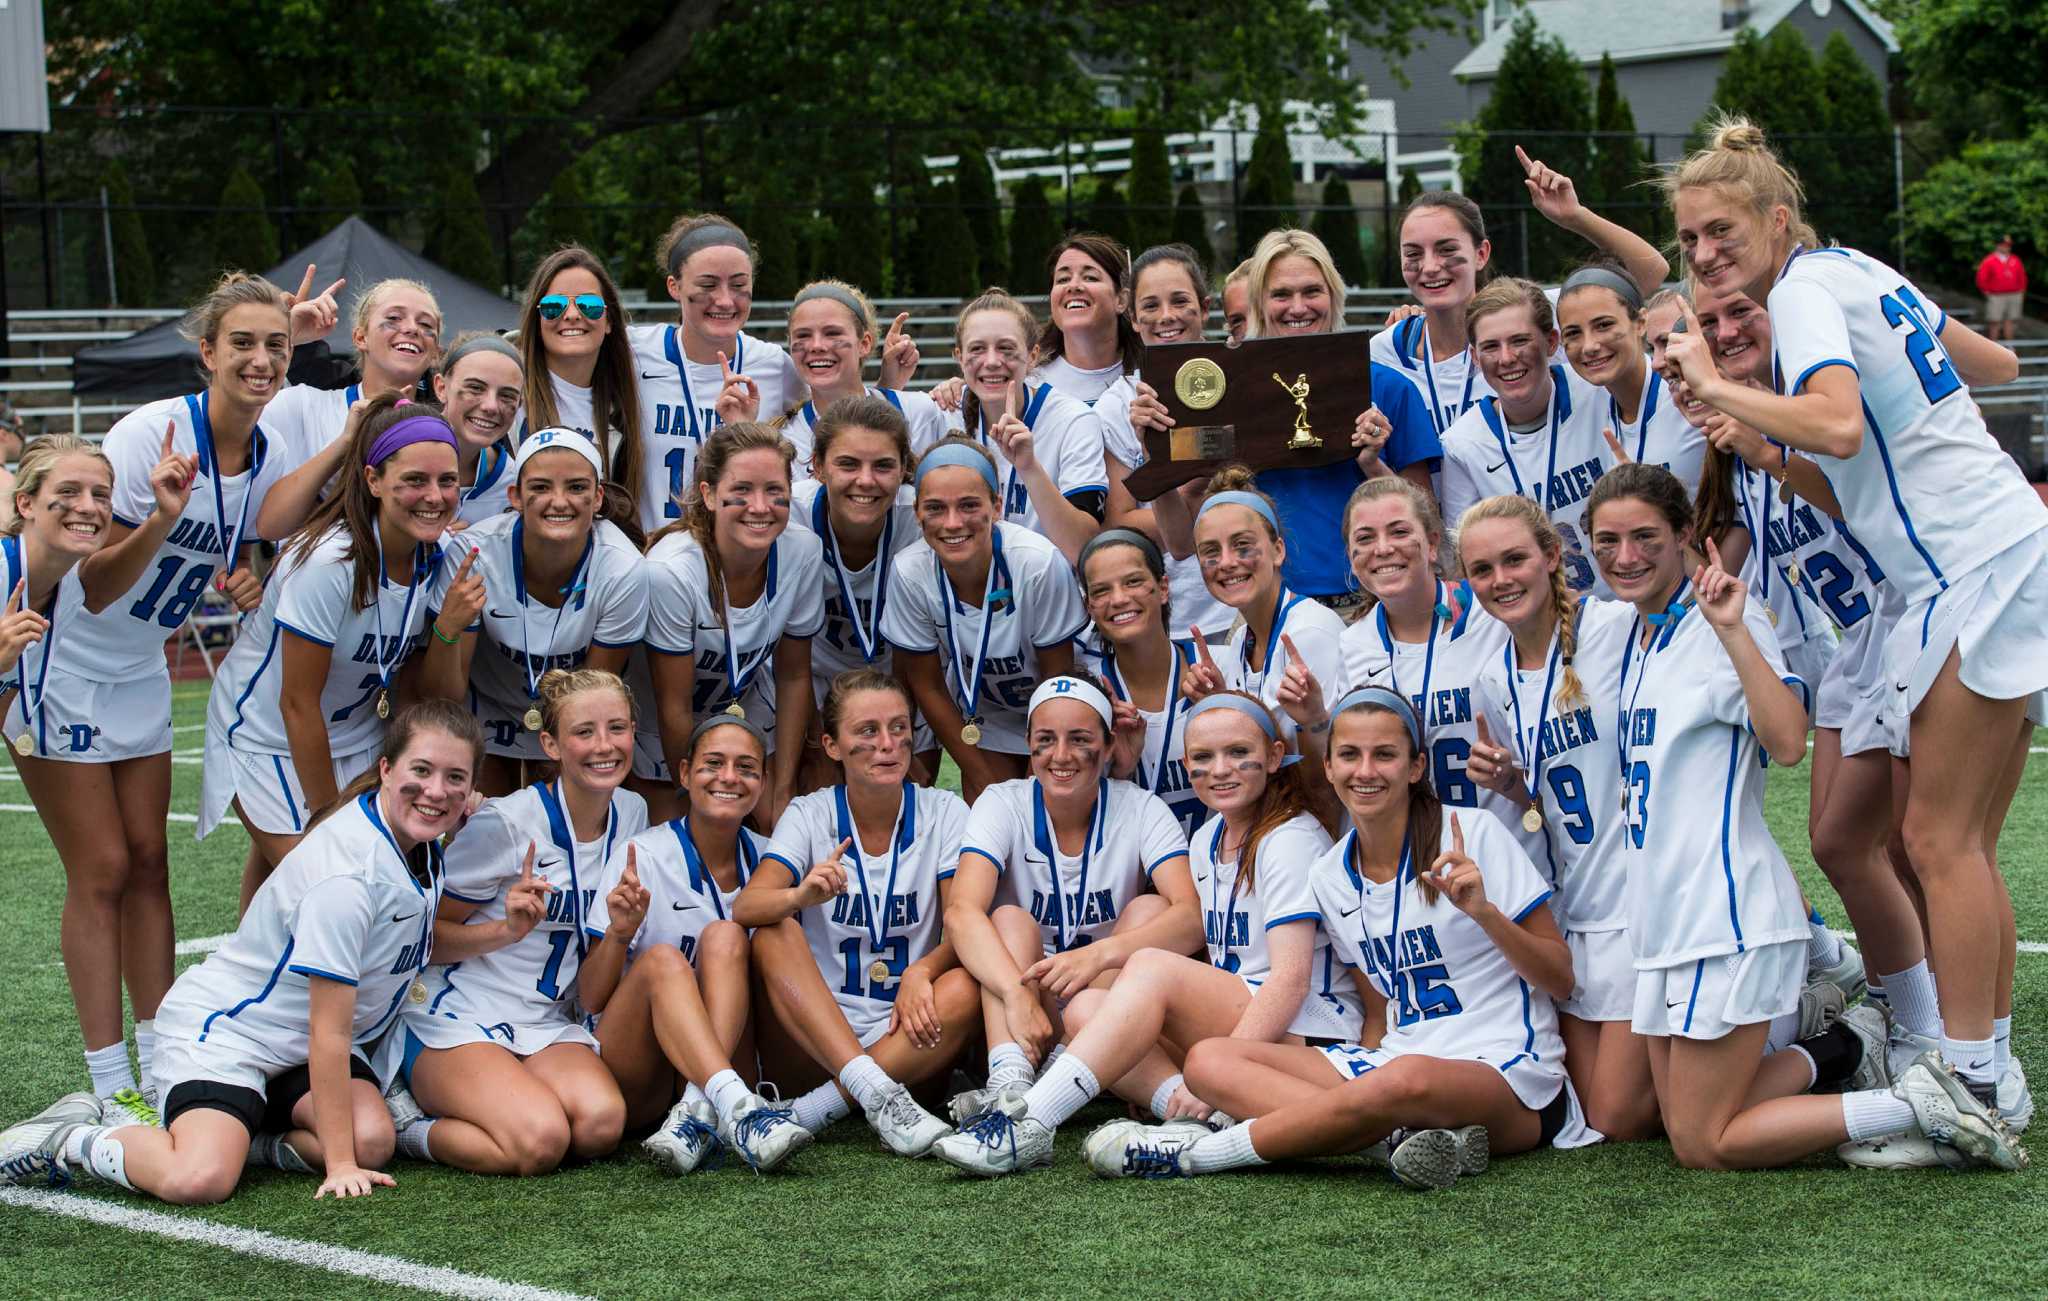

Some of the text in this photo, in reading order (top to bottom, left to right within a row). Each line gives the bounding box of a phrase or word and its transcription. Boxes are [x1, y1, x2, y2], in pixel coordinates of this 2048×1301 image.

[129, 555, 215, 629] 18
[1056, 680, 1070, 692] D
[70, 724, 92, 752] D
[1547, 764, 1595, 844] 9
[1624, 761, 1651, 849] 3
[831, 890, 919, 928] DAEN
[839, 935, 909, 1002] 12
